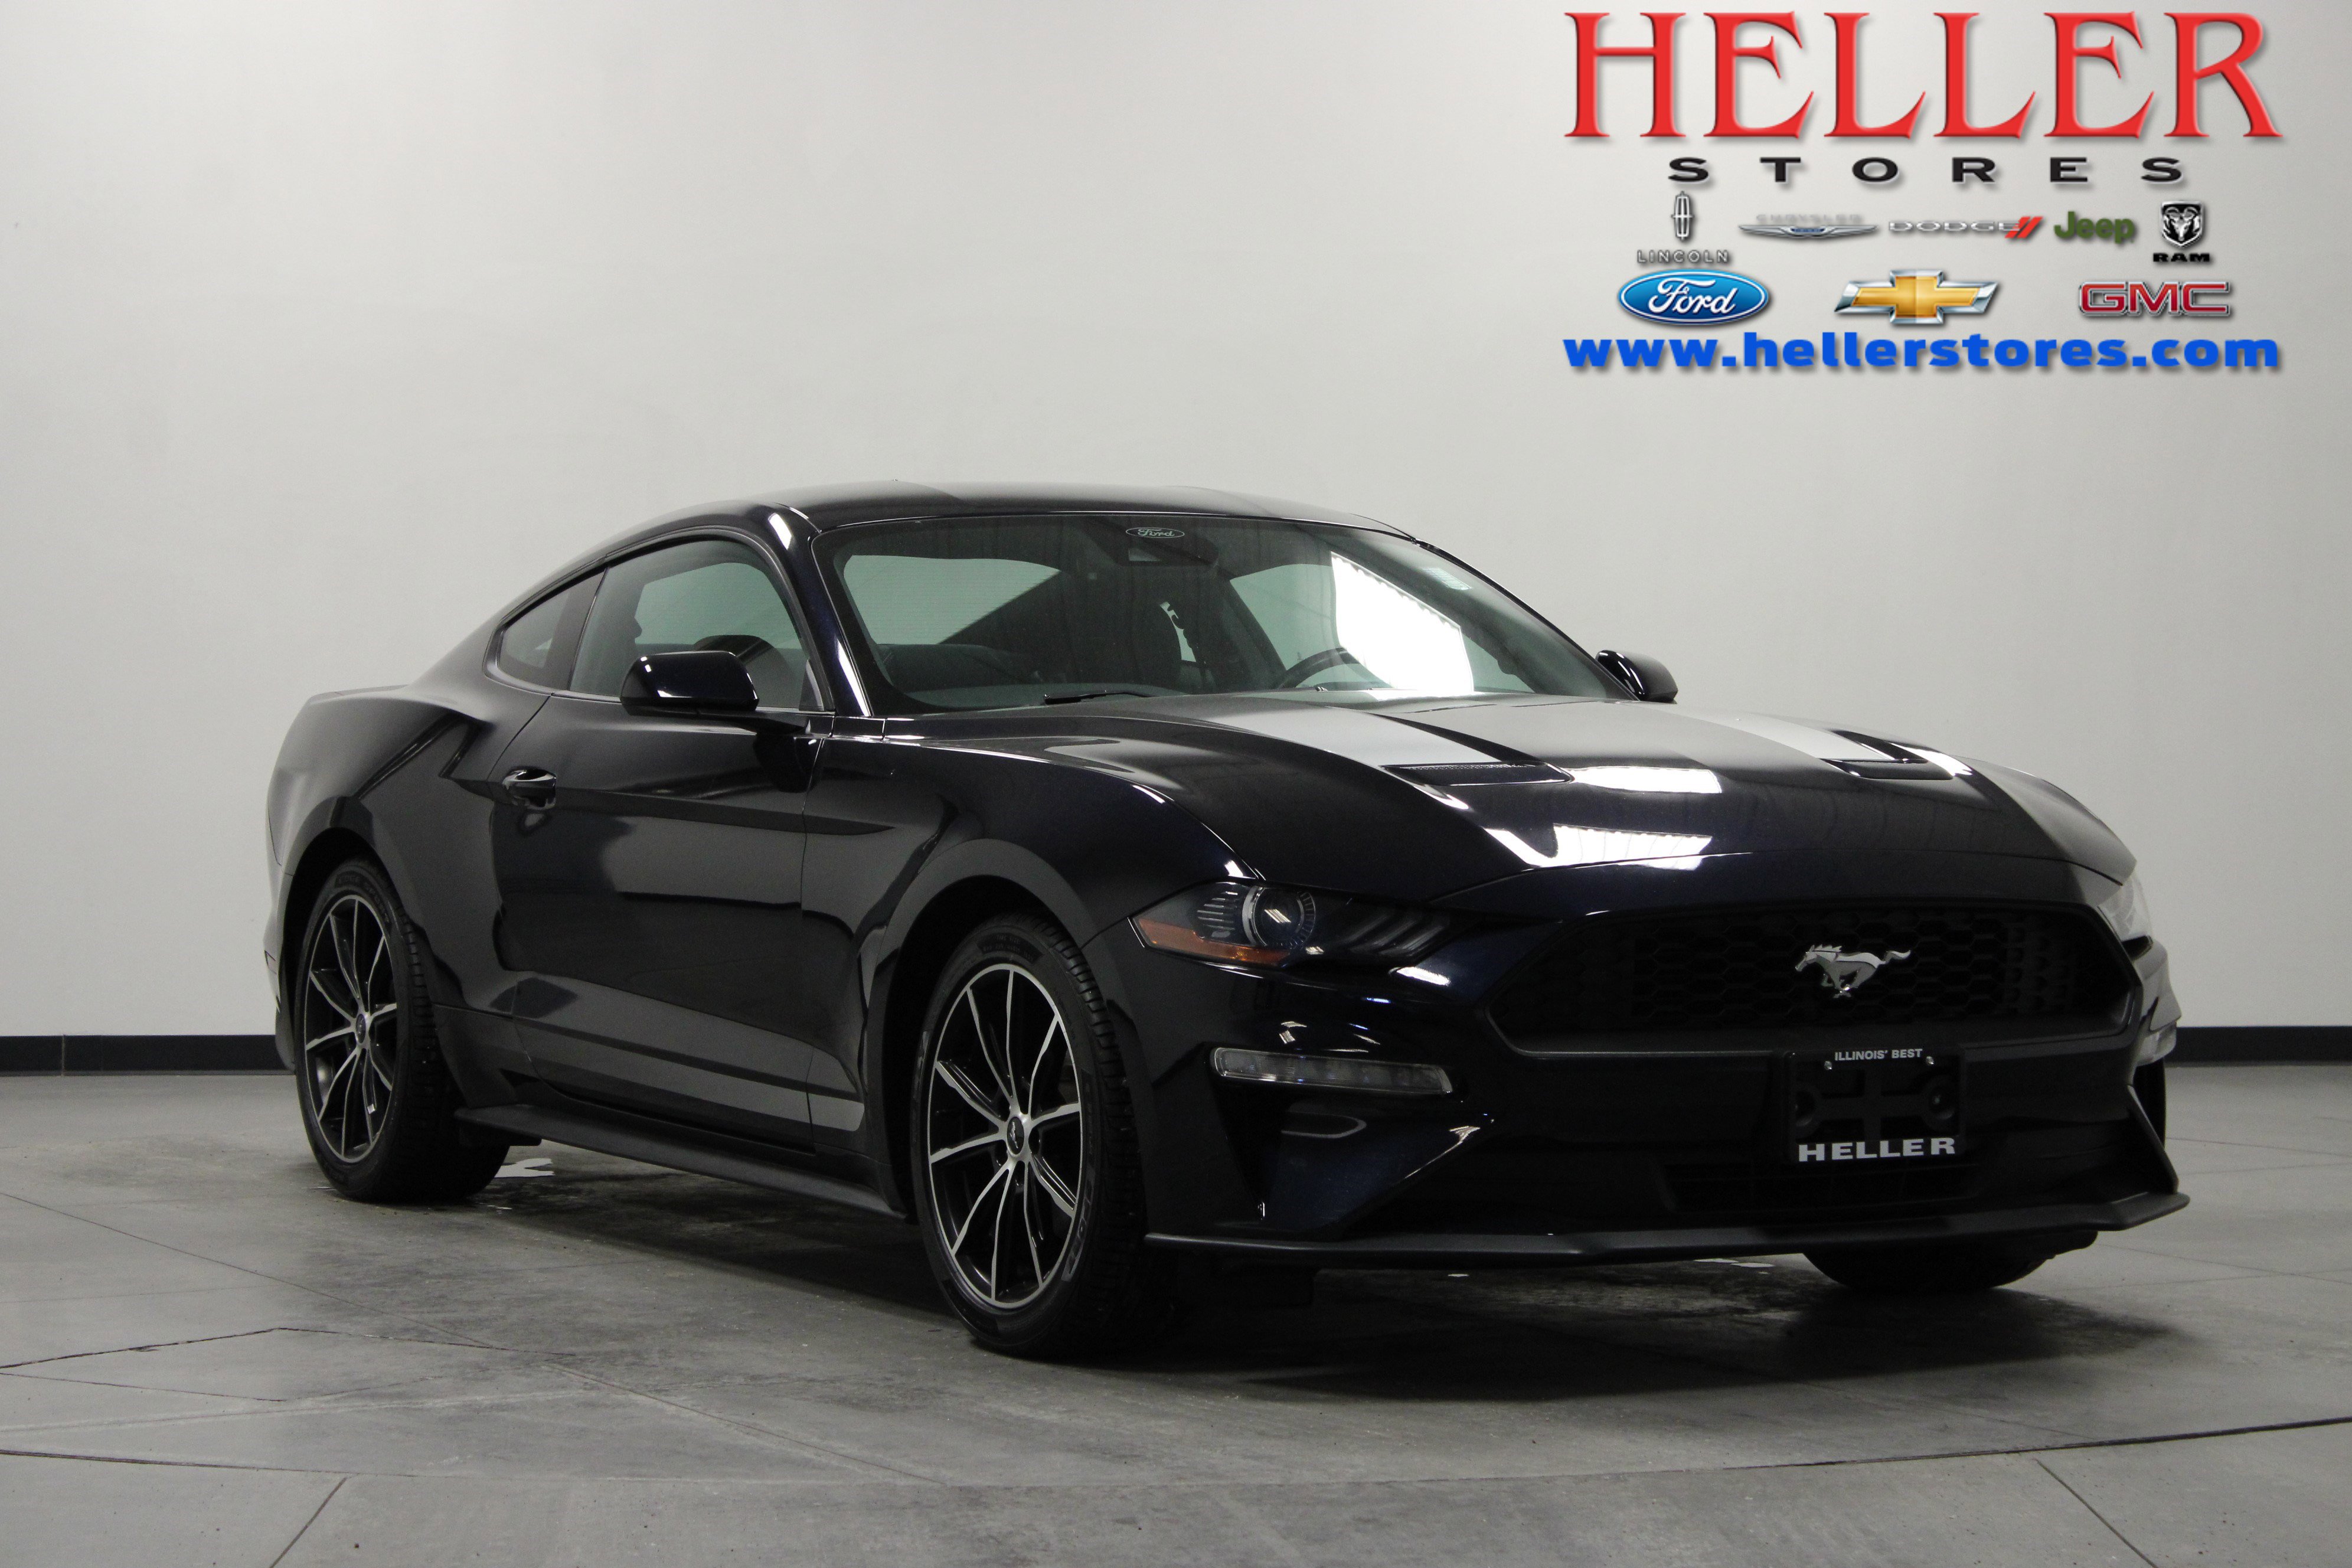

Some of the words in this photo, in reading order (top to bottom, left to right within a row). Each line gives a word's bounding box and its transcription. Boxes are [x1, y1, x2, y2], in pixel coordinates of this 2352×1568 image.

[1137, 528, 1175, 537] Ford
[1835, 1050, 1888, 1061] ILLINOIS'
[1892, 1048, 1923, 1059] BEST
[1798, 1137, 1955, 1162] HELLER
